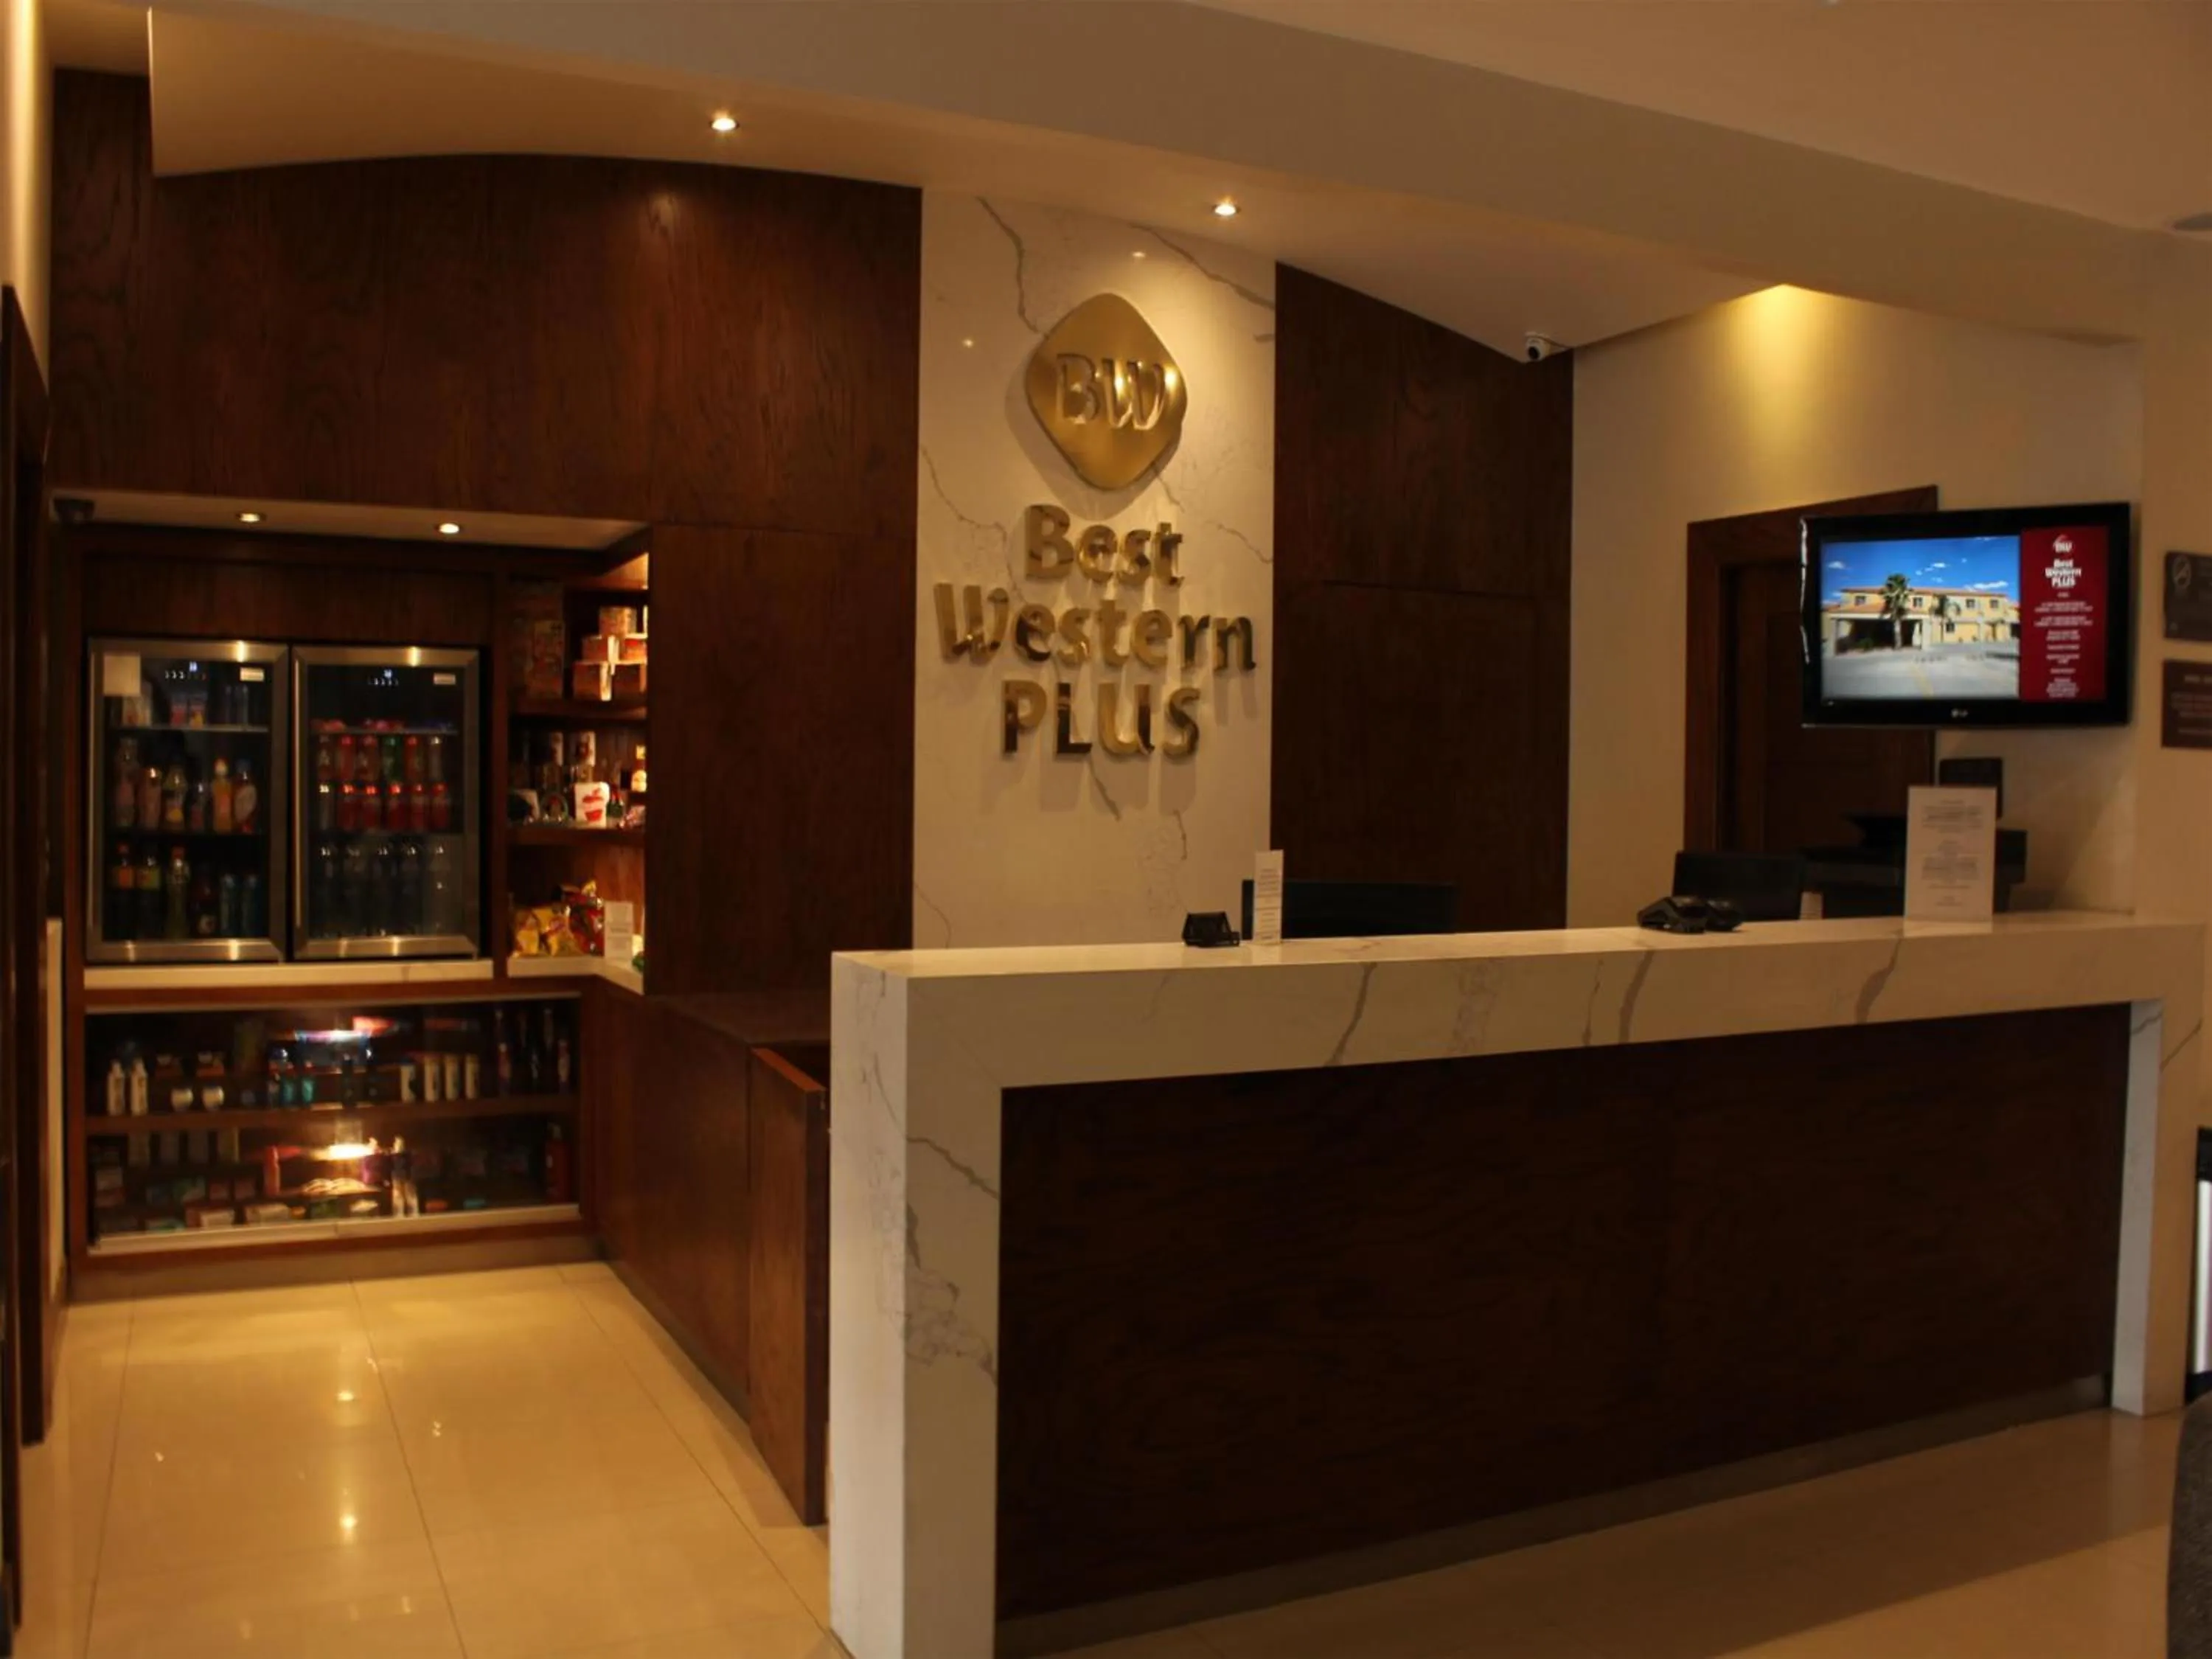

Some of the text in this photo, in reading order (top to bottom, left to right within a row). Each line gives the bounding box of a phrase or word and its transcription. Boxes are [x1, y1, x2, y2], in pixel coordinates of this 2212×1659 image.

[1055, 352, 1178, 431] BW
[1024, 504, 1184, 587] Best
[2051, 576, 2076, 588] PLUS
[933, 582, 1256, 672] Western
[1001, 679, 1203, 762] PLUS
